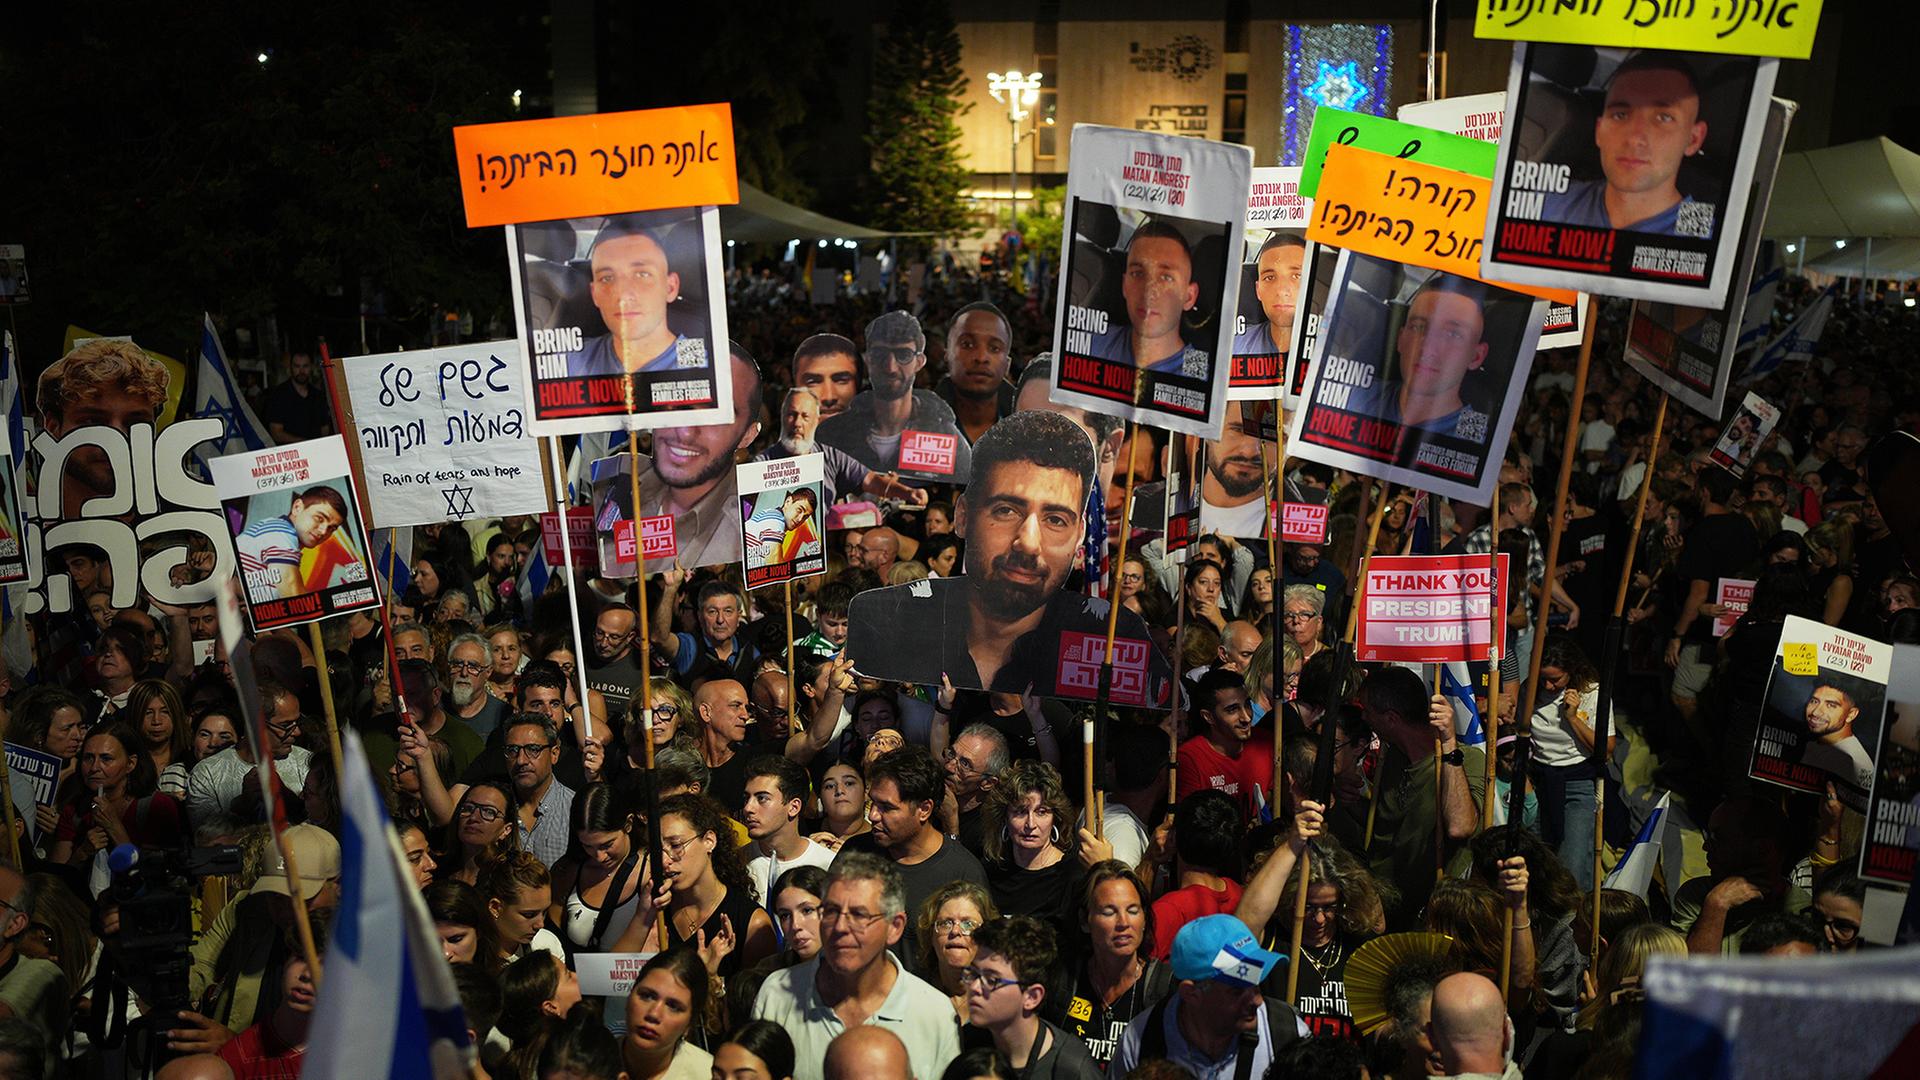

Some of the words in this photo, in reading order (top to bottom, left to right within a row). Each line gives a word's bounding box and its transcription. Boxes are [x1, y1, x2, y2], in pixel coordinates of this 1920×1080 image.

[1456, 129, 1485, 141] ATAN
[590, 143, 655, 179] חוזר
[663, 130, 719, 177] אתה
[476, 148, 577, 193] הביתה!
[1123, 166, 1151, 183] MATAN
[1152, 170, 1191, 189] ANGREST
[1510, 160, 1571, 194] BRING
[1383, 170, 1476, 218] קורה!
[1505, 190, 1545, 221] HIM
[1319, 200, 1414, 246] הביתה!
[1501, 222, 1557, 254] HOME
[1558, 229, 1616, 262] NOW!
[1631, 255, 1672, 273] FAMILIES
[1672, 259, 1705, 278] FORUM
[1068, 304, 1109, 335] BRING
[533, 326, 583, 354] BRING
[1066, 329, 1092, 356] HIM
[439, 355, 510, 400] גשם
[536, 353, 568, 379] HIM
[1064, 356, 1102, 385] HOME
[1103, 364, 1138, 393] NOW
[1247, 353, 1284, 377] NOW!
[1323, 355, 1375, 388] BRING
[379, 362, 421, 407] של
[539, 379, 586, 407] HOME
[1316, 380, 1351, 409] HIM
[361, 418, 427, 456] ותקווה
[443, 410, 523, 446] דמעות
[1309, 407, 1358, 441] HOME
[918, 435, 952, 450] עדיין
[252, 463, 282, 478] MAKSYM
[283, 458, 309, 472] HARKIN
[907, 451, 951, 465] בעזה.
[1416, 450, 1450, 469] FAMILIES
[1449, 459, 1477, 477] FORUM
[382, 473, 412, 487] Rain
[435, 470, 465, 481] tears
[470, 467, 490, 477] and
[494, 466, 521, 479] hope
[1286, 505, 1324, 520] עדיין
[244, 568, 282, 589] BRING
[748, 567, 768, 583] HOME
[769, 561, 790, 577] NOW!
[1371, 574, 1447, 590] THANK
[1452, 573, 1491, 589] YOU
[249, 584, 273, 605] HIM
[1725, 587, 1751, 597] THA
[254, 601, 288, 622] HOME
[288, 592, 322, 615] NOW!
[1371, 599, 1491, 616] PRESIDENT
[1395, 625, 1470, 641] TRUMP
[1823, 642, 1852, 657] EVYATAR
[1852, 651, 1873, 665] DAVID
[1826, 655, 1848, 669] (23)
[1069, 666, 1140, 692] בעה.
[1759, 739, 1783, 758] HIM
[1762, 725, 1797, 746] BRING
[42, 762, 55, 778] עד
[1757, 756, 1789, 777] HOME
[1876, 798, 1920, 827] BRIN
[1873, 822, 1906, 847] HIM
[1069, 999, 1092, 1017] 736
